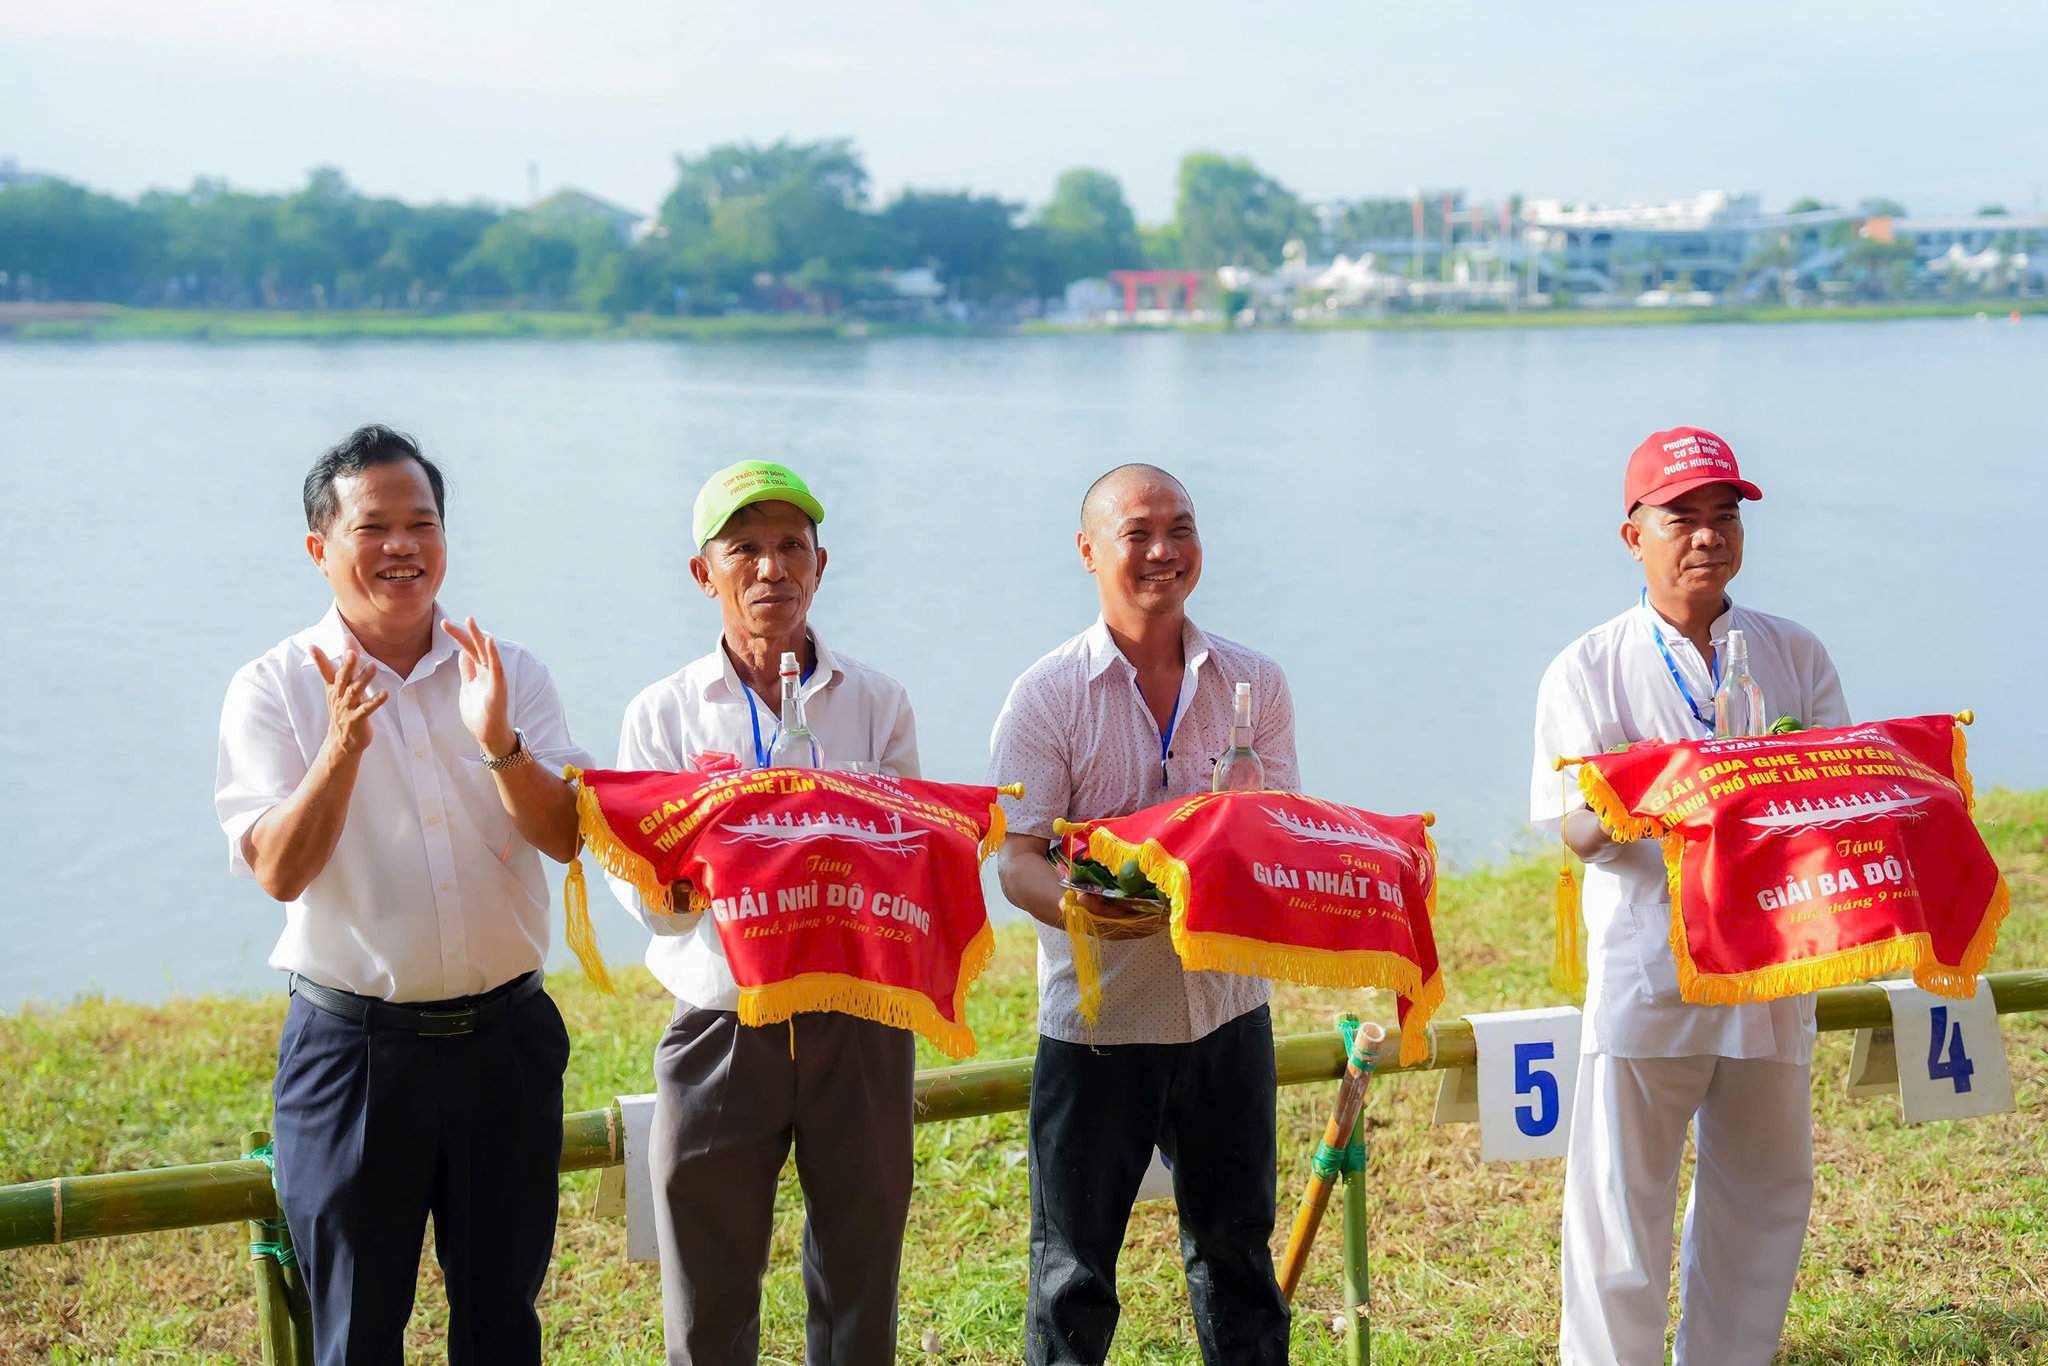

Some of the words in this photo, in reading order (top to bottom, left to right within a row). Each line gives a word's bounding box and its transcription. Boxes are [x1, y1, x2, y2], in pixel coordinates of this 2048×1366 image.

[1664, 460, 1689, 475] QUỐC
[1689, 457, 1714, 468] HÙNG
[1673, 448, 1687, 459] CƠ
[1688, 443, 1701, 455] SỞ
[740, 777, 775, 795] HUẾ
[780, 775, 816, 795] LẦN
[1649, 777, 1695, 812] GIẢI
[1698, 759, 1749, 783] ĐUA
[1752, 753, 1801, 768] GHE
[1804, 745, 1896, 763] TRUYỀN
[1660, 791, 1709, 829] THÀNH
[1709, 773, 1746, 800] PHỐ
[1747, 767, 1784, 787] HUẾ
[1783, 765, 1818, 782] LẦN
[1818, 762, 1851, 778] THỨ
[1854, 764, 1906, 777] XXXVII
[638, 798, 688, 835] GIẢI
[1835, 839, 1886, 858] Tặng
[805, 854, 854, 876] Tặng
[1338, 853, 1382, 875] Tặng
[1253, 862, 1300, 889] GIẢI
[1305, 868, 1370, 899] NHẤT
[1378, 880, 1404, 912] ĐỘ
[1756, 875, 1813, 912] GIẢI
[1817, 868, 1859, 897] BA
[1862, 855, 1904, 886] ĐỘ
[711, 886, 769, 923] GIẢI
[777, 879, 820, 913] NHÌ
[826, 882, 865, 915] ĐỘ
[871, 892, 931, 936] CÚNG
[1288, 896, 1318, 912] Huế,
[1321, 904, 1362, 919] tháng
[1367, 907, 1377, 917] 9
[1827, 895, 1874, 914] tháng
[1878, 891, 1888, 902] 9
[743, 920, 784, 939] Huế,
[787, 916, 821, 932] tháng
[826, 914, 835, 925] 9
[839, 917, 871, 934] năm
[874, 924, 914, 944] 2026
[1928, 1005, 1974, 1095] 4
[1514, 1040, 1561, 1138] 5
